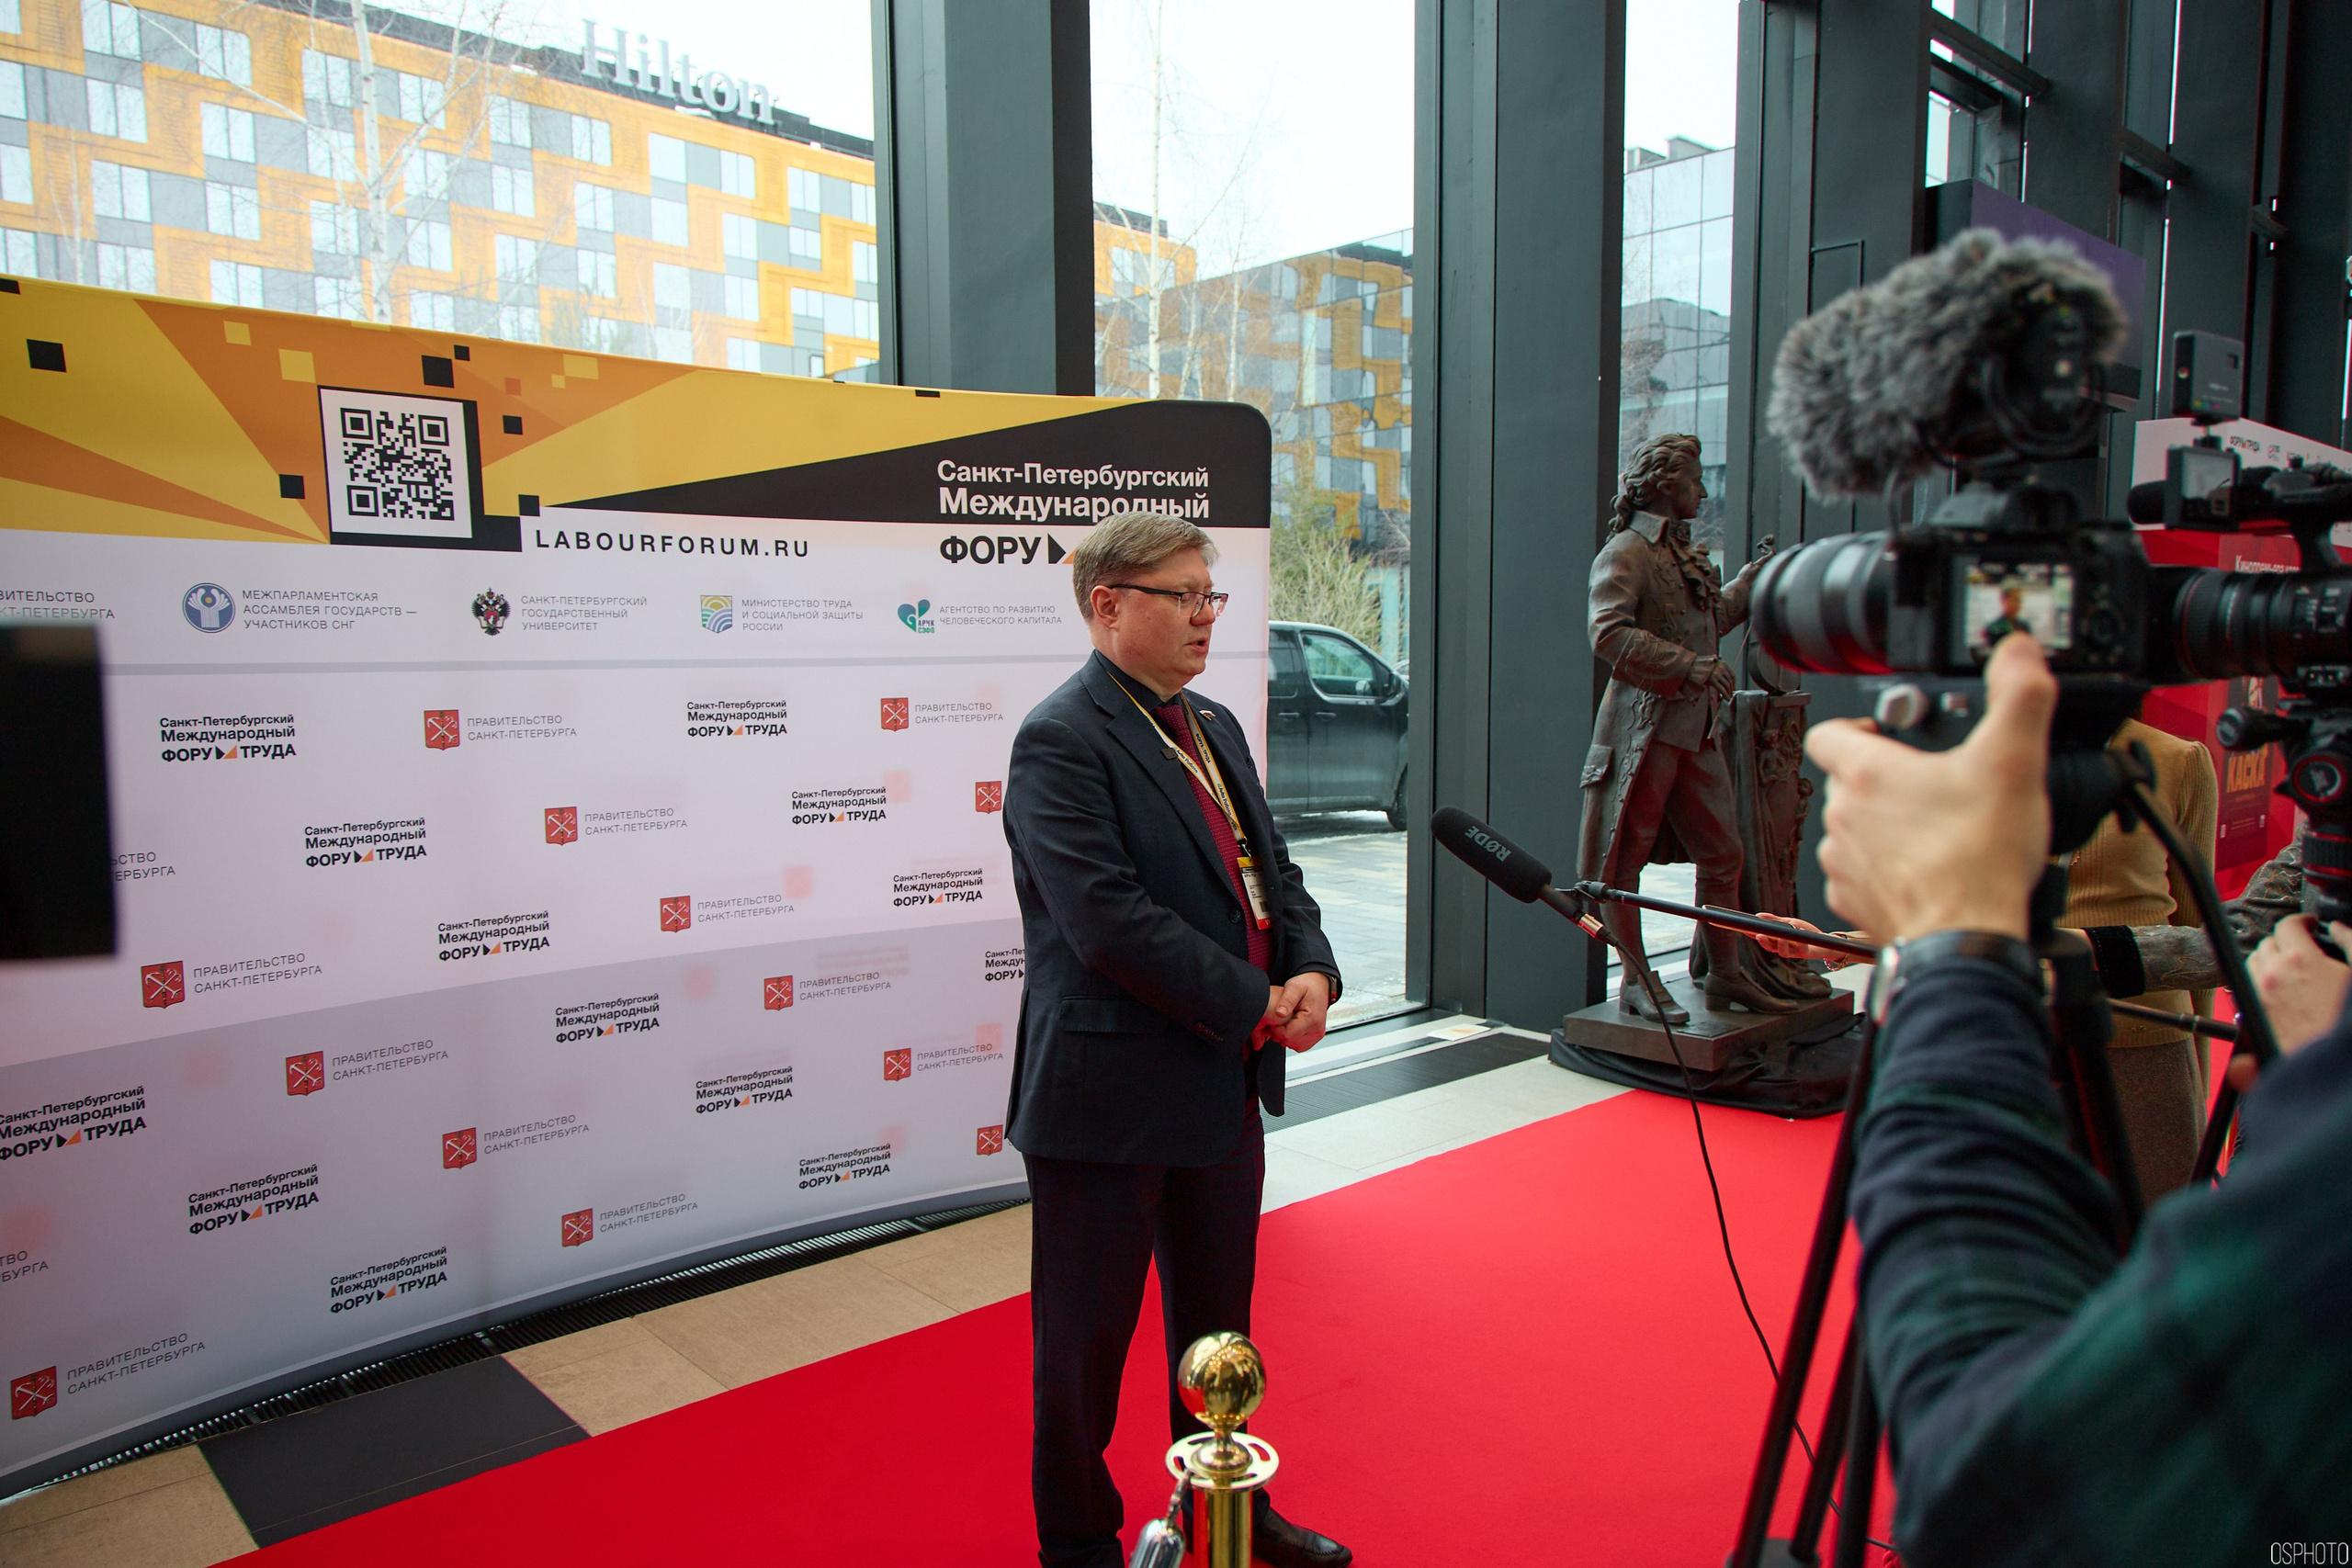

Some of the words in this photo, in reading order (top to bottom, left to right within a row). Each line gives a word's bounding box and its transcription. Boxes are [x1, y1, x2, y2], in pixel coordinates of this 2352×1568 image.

[582, 18, 777, 125] Hilton
[937, 459, 1209, 490] Санкт-Петербургский
[939, 487, 1209, 522] Международный
[536, 529, 809, 558] LABOURFORUM.RU
[243, 590, 379, 602] МЕЖПАРЛАМЕНТСКАЯ
[521, 595, 647, 607] САНКТ-ПЕТЕРБУРГСКИЙ
[741, 599, 820, 609] МИНИСТЕРСТВО
[823, 600, 853, 609] ТРУДА
[243, 604, 319, 616] АССАМБЛЕЯ
[324, 605, 401, 618] ГОСУДАРСТВ
[522, 607, 628, 620] ГОСУДАРСТВЕННЫЙ
[741, 611, 748, 619] И
[752, 610, 820, 621] СОЦИАЛЬНОЙ
[822, 611, 864, 621] ЗАЩИТЫ
[244, 619, 327, 630] УЧАСТНИКОВ
[332, 619, 355, 630] СНГ
[522, 622, 598, 631] УНИВЕРСИТЕТ
[742, 623, 784, 632] РОССИИ
[940, 616, 1014, 625] ЧЕЛОВЕЧЕСКОГО
[1018, 616, 1062, 625] КАПИТАЛА
[687, 699, 787, 711] Санкт-Петербургский
[915, 703, 992, 712] ПРАВИТЕЛЬСТВО
[160, 715, 294, 728] Санкт-Петербургский
[467, 715, 562, 727] ПРАВИТЕЛЬСТВО
[687, 709, 787, 722] Международный
[915, 713, 1003, 724] САНКТ-ПЕТЕРБУРГА
[161, 726, 295, 742] Международный
[468, 728, 577, 740] САНКТ-ПЕТЕРБУРГА
[745, 724, 787, 736] ТРУДА
[240, 743, 296, 760] ТРУДА
[792, 786, 887, 799] Санкт-Петербургский
[792, 795, 887, 810] Международный
[584, 807, 674, 822] ПРАВИТЕЛЬСТВО
[846, 809, 887, 821] ТРУДА
[304, 818, 425, 836] Санкт-Петербургский
[585, 819, 687, 836] САНКТ-ПЕТЕРБУРГА
[305, 829, 426, 850] Международный
[1464, 826, 1511, 862] RØDE
[376, 845, 427, 862] ТРУДА
[893, 868, 983, 882] Санкт-Петербургский
[894, 877, 983, 893] Международный
[697, 894, 782, 909] ПРАВИТЕЛЬСТВО
[945, 891, 983, 903] ТРУДА
[438, 911, 548, 931] Санкт-Петербургский
[697, 905, 794, 922] САНКТ-ПЕТЕРБУРГА
[439, 921, 549, 944] Международный
[503, 937, 549, 953] ТРУДА
[194, 953, 305, 978] ПРАВИТЕЛЬСТВО
[194, 964, 322, 993] САНКТ-ПЕТЕРБУРГА
[799, 972, 879, 988] ПРАВИТЕЛЬСТВО
[799, 982, 891, 1000] САНКТ-ПЕТЕРБУРГА
[556, 993, 659, 1015] Санкт-Петербургский
[556, 1003, 660, 1028] Международный
[616, 1017, 660, 1034] ТРУДА
[333, 1040, 434, 1066] ПРАВИТЕЛЬСТВО
[917, 1043, 992, 1060] ПРАВИТЕЛЬСТВО
[333, 1051, 448, 1081] САНКТ-ПЕТЕРБУРГА
[917, 1053, 1003, 1071] САНКТ-ПЕТЕРБУРГА
[696, 1066, 792, 1089] Санкт-Петербургский
[696, 1075, 793, 1100] Международный
[752, 1089, 792, 1104] ТРУДА
[84, 1116, 147, 1142] ТРУДА
[484, 1114, 576, 1142] ПРАВИТЕЛЬСТВО
[484, 1124, 589, 1155] САНКТ-ПЕТЕРБУРГА
[799, 1143, 891, 1167] Санкт-Петербургский
[799, 1152, 891, 1177] Международный
[852, 1164, 890, 1180] ТРУДА
[188, 1164, 318, 1203] Санкт-Петербургский
[189, 1174, 319, 1218] Международный
[265, 1191, 319, 1216] ТРУДА
[600, 1194, 685, 1221] ПРАВИТЕЛЬСТВО
[600, 1202, 698, 1233] САНКТ-ПЕТЕРБУРГА
[331, 1246, 447, 1287] Санкт-Петербургский
[331, 1256, 447, 1299] Международный
[399, 1272, 447, 1295] ТРУДА
[67, 1333, 188, 1380] ПРАВИТЕЛЬСТВО
[67, 1342, 206, 1394] САНКТ-ПЕТЕРБУРГА
